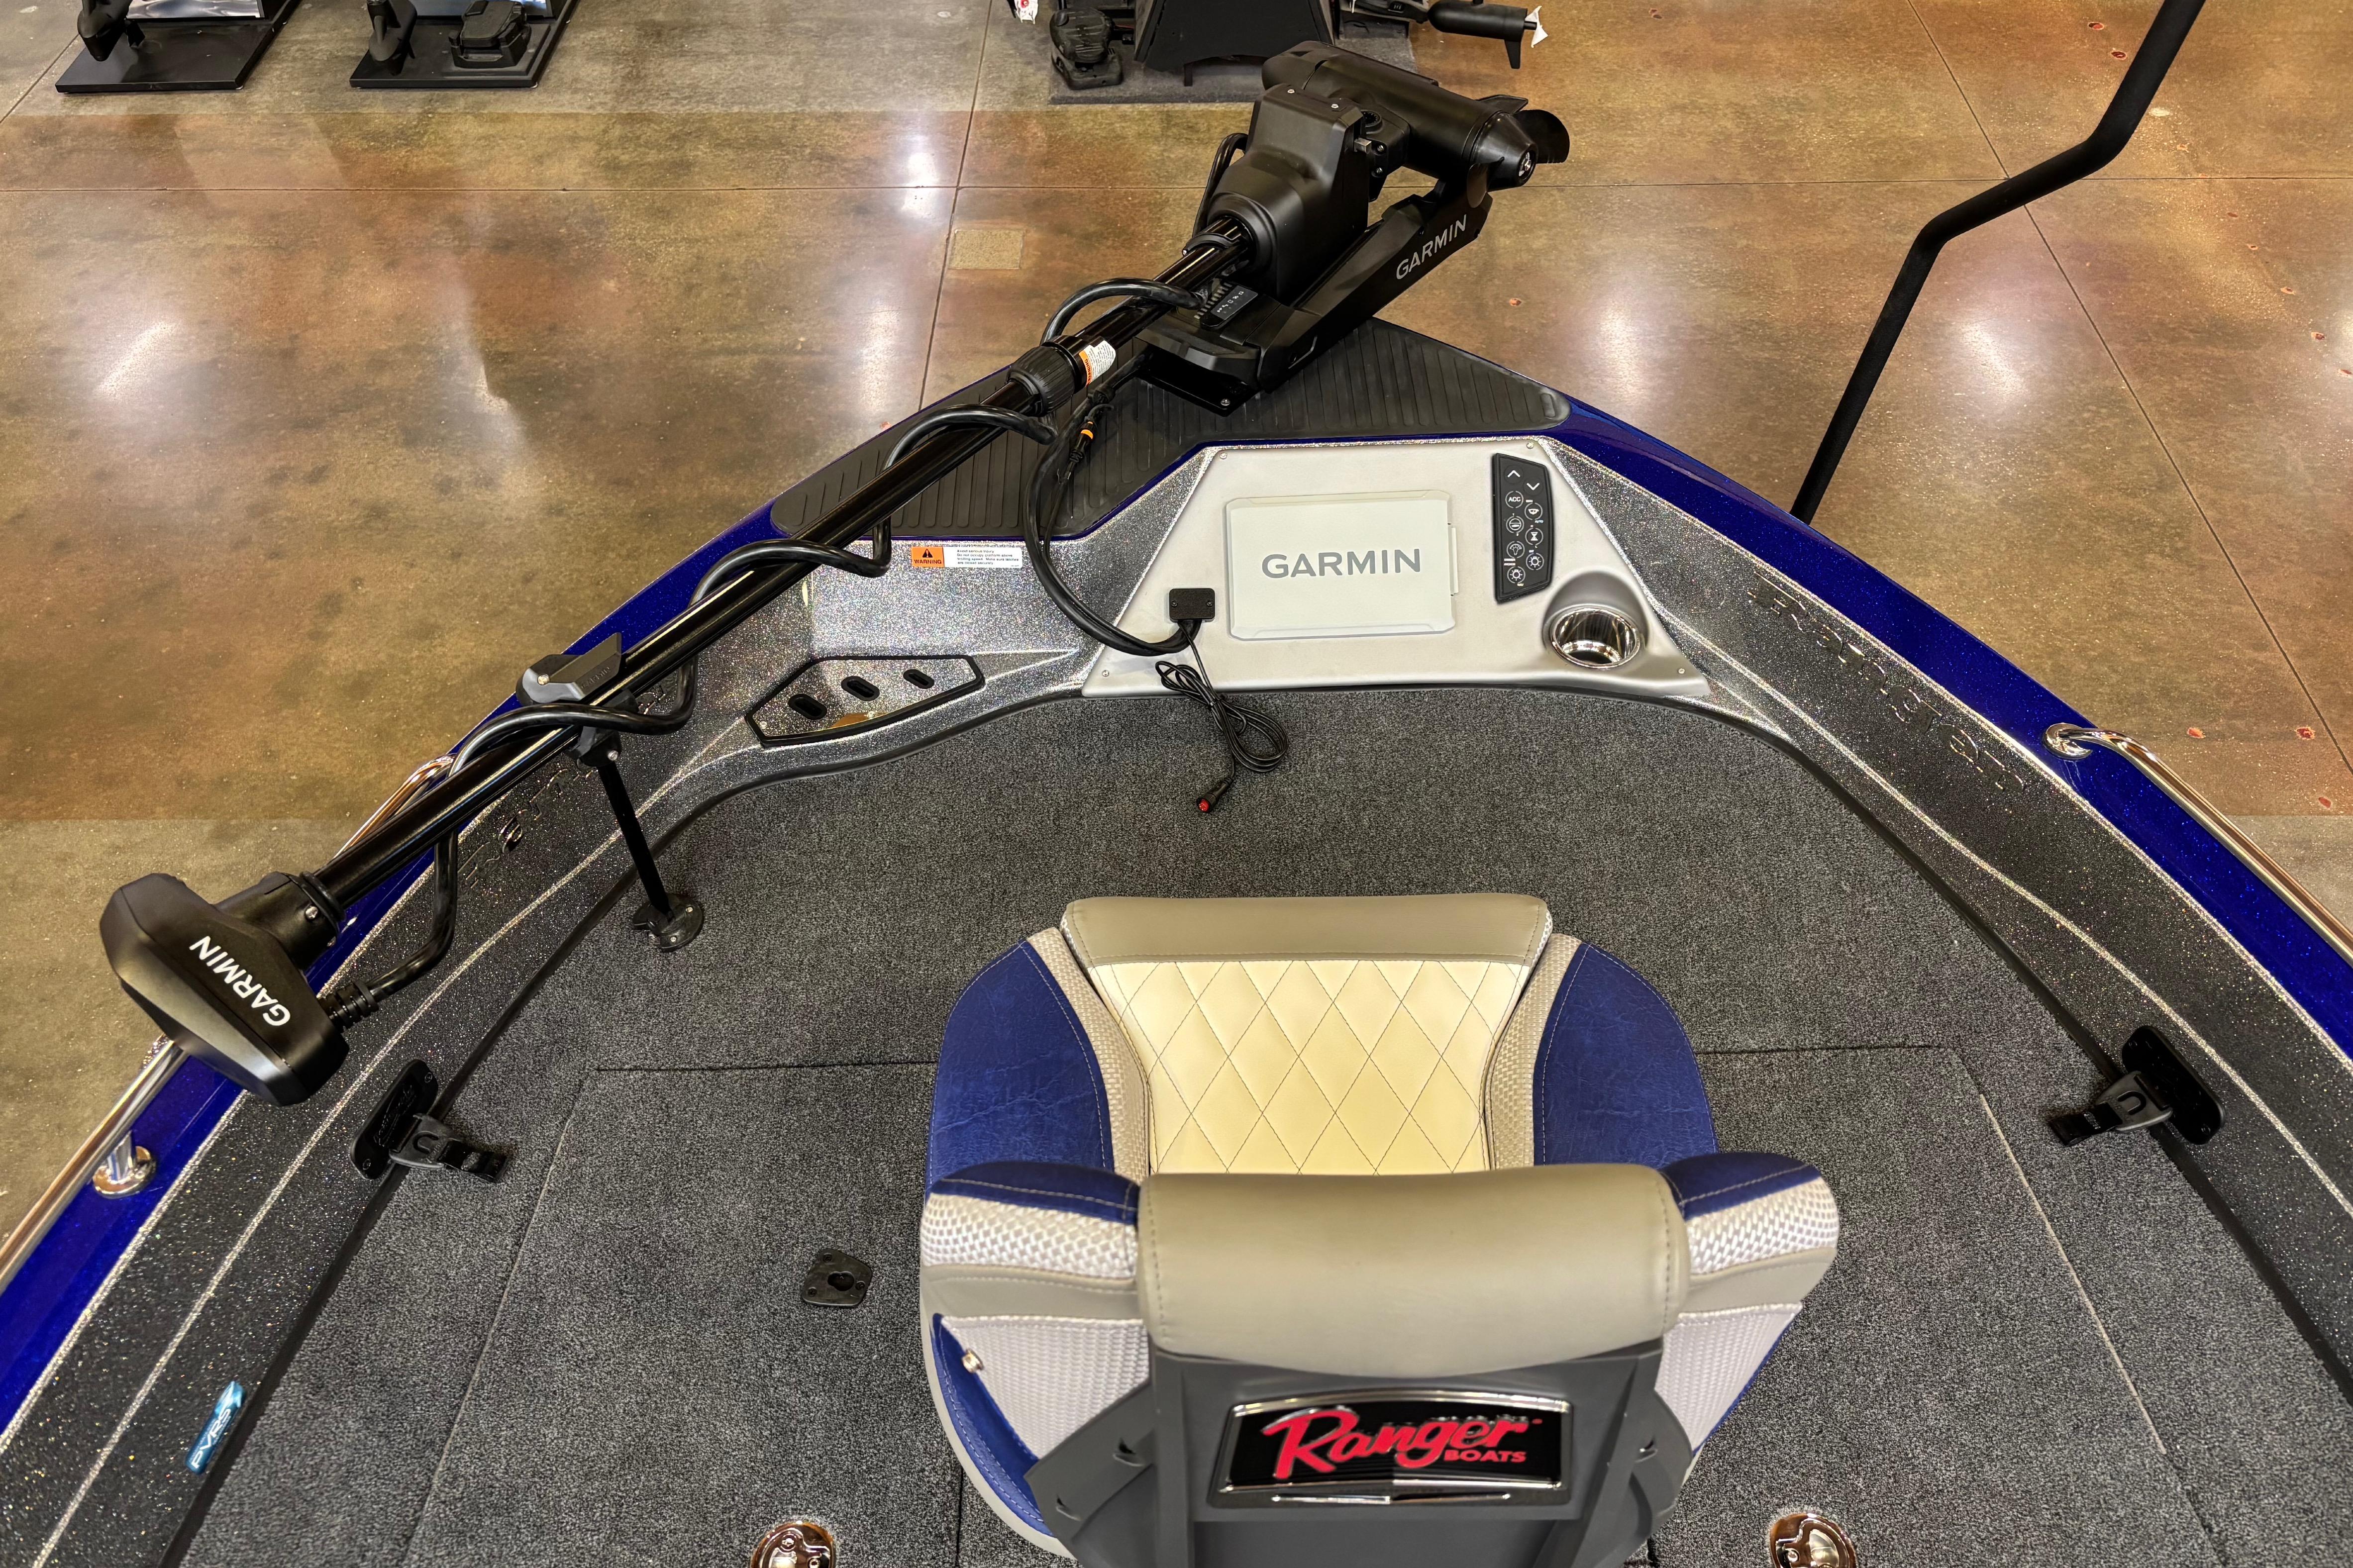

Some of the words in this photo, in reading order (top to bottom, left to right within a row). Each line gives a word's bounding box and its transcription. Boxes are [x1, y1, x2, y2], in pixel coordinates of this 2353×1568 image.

[1396, 214, 1467, 280] GARMIN
[1261, 548, 1421, 579] GARMIN
[189, 935, 291, 1026] GARMIN
[1261, 1405, 1530, 1479] Ranger
[1443, 1449, 1527, 1463] BOATS
